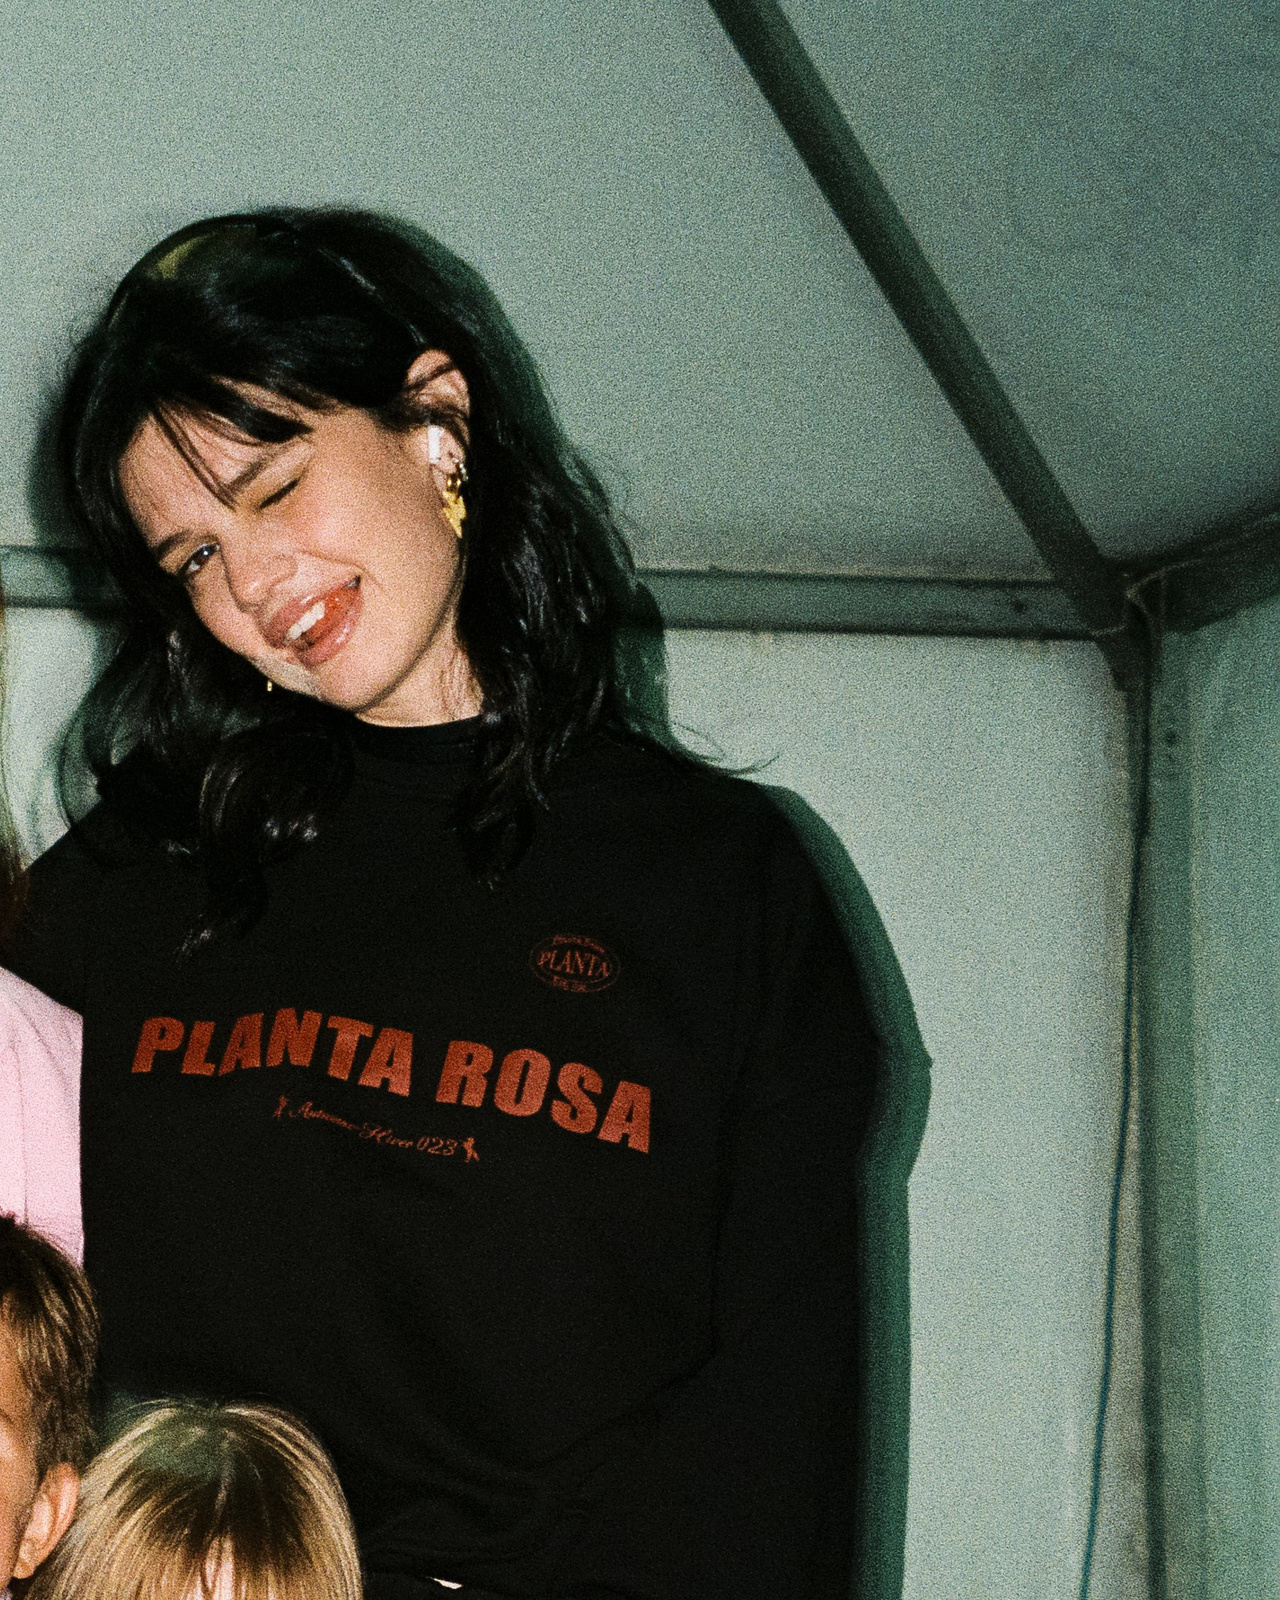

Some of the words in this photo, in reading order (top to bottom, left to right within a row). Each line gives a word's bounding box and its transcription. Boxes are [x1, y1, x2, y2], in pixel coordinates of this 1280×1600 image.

[538, 950, 609, 977] PLANTA
[131, 1007, 414, 1097] PLANTA
[435, 1039, 652, 1154] ROSA
[417, 1136, 458, 1156] 023
